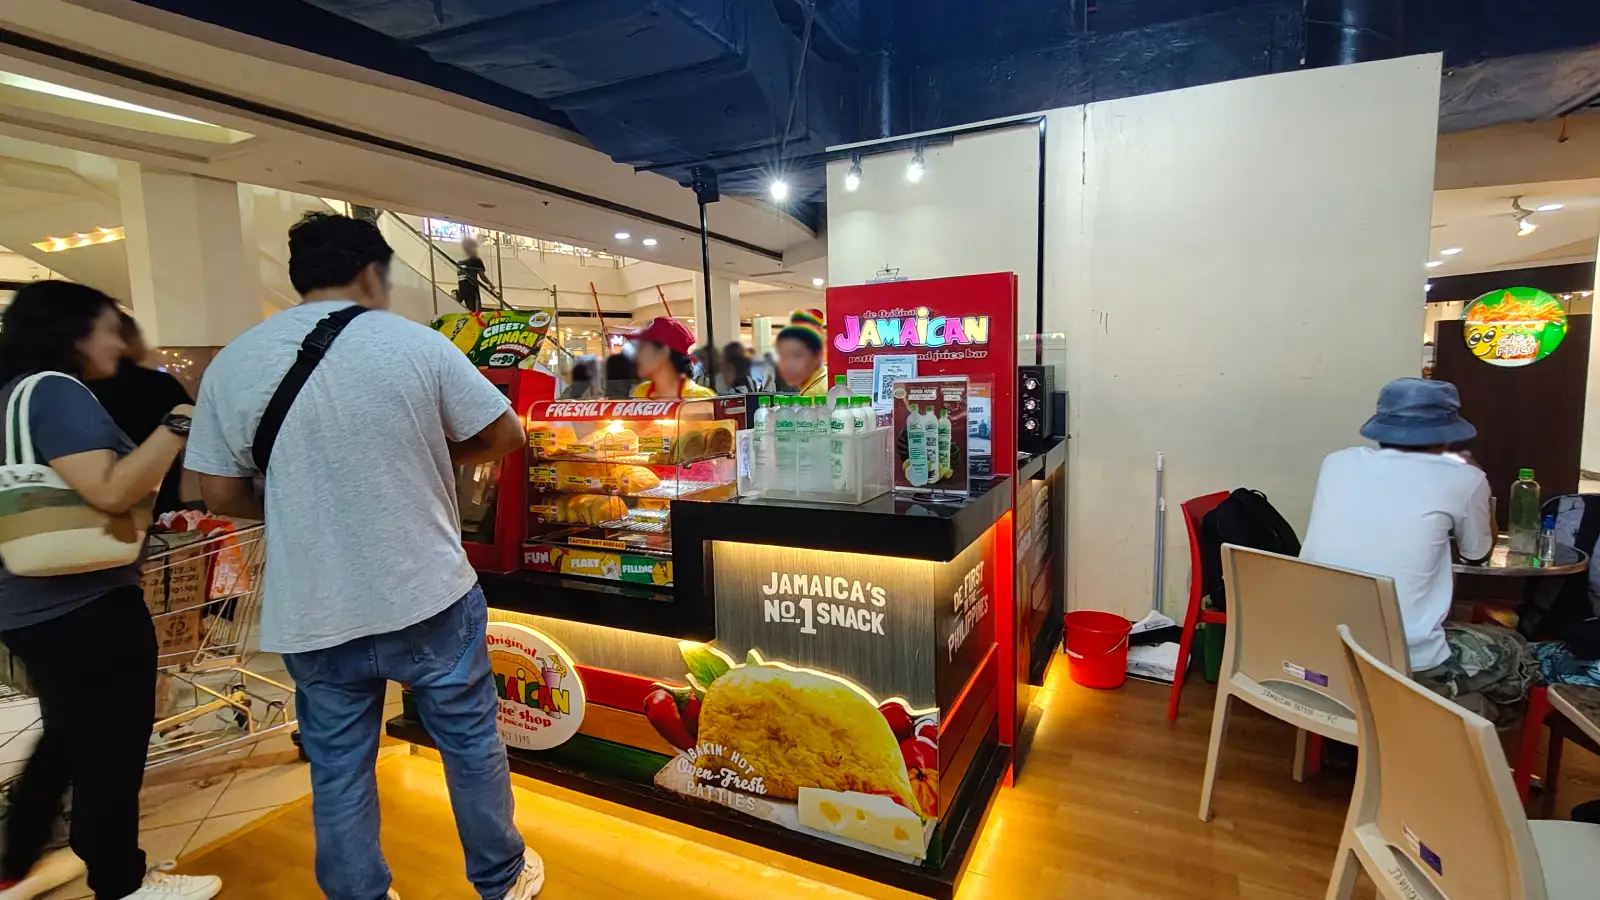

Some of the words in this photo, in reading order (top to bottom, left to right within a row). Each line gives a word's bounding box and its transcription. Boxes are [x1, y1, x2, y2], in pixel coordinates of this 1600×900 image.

[489, 316, 511, 325] NEW!
[483, 323, 526, 338] CHEEZY
[480, 331, 539, 351] SPINACH
[1499, 335, 1536, 347] GIGA
[916, 351, 932, 360] nd
[932, 349, 964, 361] juice
[965, 348, 987, 358] bar
[1496, 345, 1535, 356] FRIES
[545, 403, 611, 417] FRESHLY
[612, 402, 674, 416] BAKED!
[524, 552, 549, 564] FUN
[571, 558, 600, 568] FLAKY
[622, 565, 653, 573] FILLING
[762, 571, 886, 607] JAMAICA'S
[953, 584, 964, 613] DE
[964, 560, 985, 598] FIRST
[816, 602, 885, 636] SNACK
[947, 593, 989, 665] PHILIPPINES
[519, 709, 552, 727] shop
[687, 743, 727, 763] BAKIN'
[730, 751, 755, 775] HOT
[676, 757, 767, 795] Oven-Fresh
[686, 780, 756, 811] PATTIES
